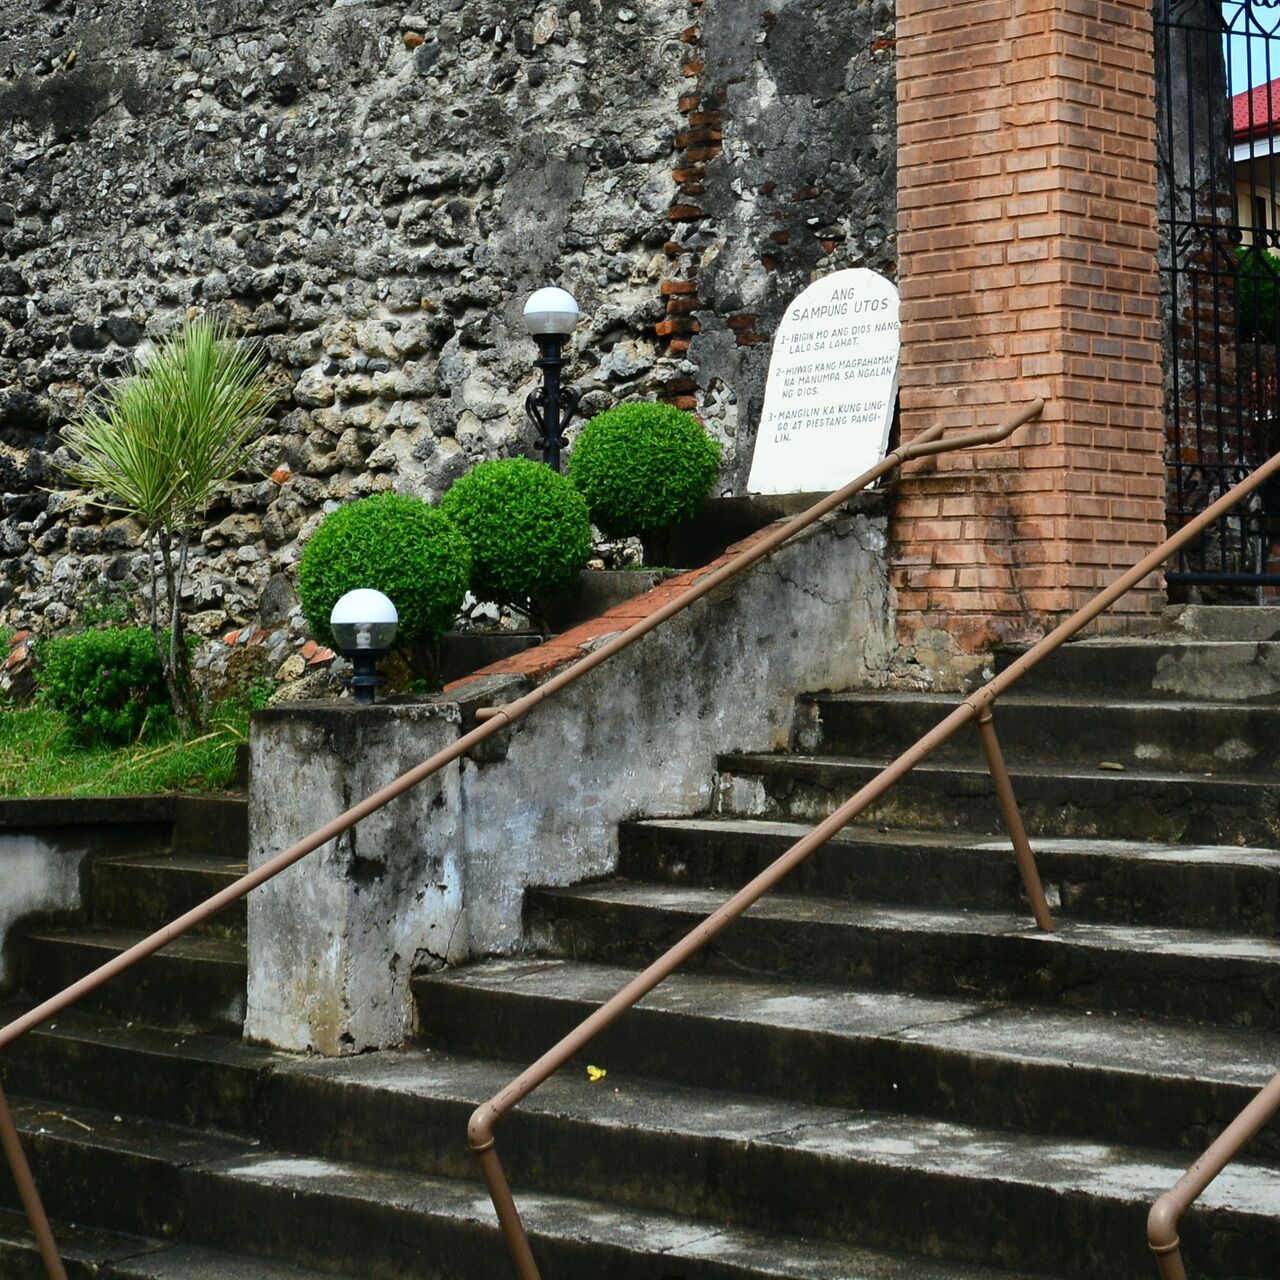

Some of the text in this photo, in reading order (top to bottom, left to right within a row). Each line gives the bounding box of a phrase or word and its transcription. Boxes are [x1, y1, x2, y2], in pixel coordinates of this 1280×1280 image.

[831, 287, 854, 302] ANG
[792, 298, 888, 321] SAMPUNG UTOS
[816, 330, 828, 339] MO
[831, 327, 849, 338] ANG
[852, 324, 871, 335] DIOS
[875, 321, 899, 332] NANG
[789, 343, 811, 354] LALO
[814, 342, 825, 351] SA
[815, 361, 837, 372] KANG
[839, 355, 895, 369] MAGPAHAMAK
[784, 366, 892, 387] NA MANUMPA SA NGALAN
[782, 390, 793, 399] NG
[823, 406, 835, 416] KA
[838, 402, 861, 414] KUNG
[864, 400, 886, 411] LING-
[777, 422, 788, 431] GO
[792, 420, 803, 430] AT
[806, 416, 847, 429] PIESTANG
